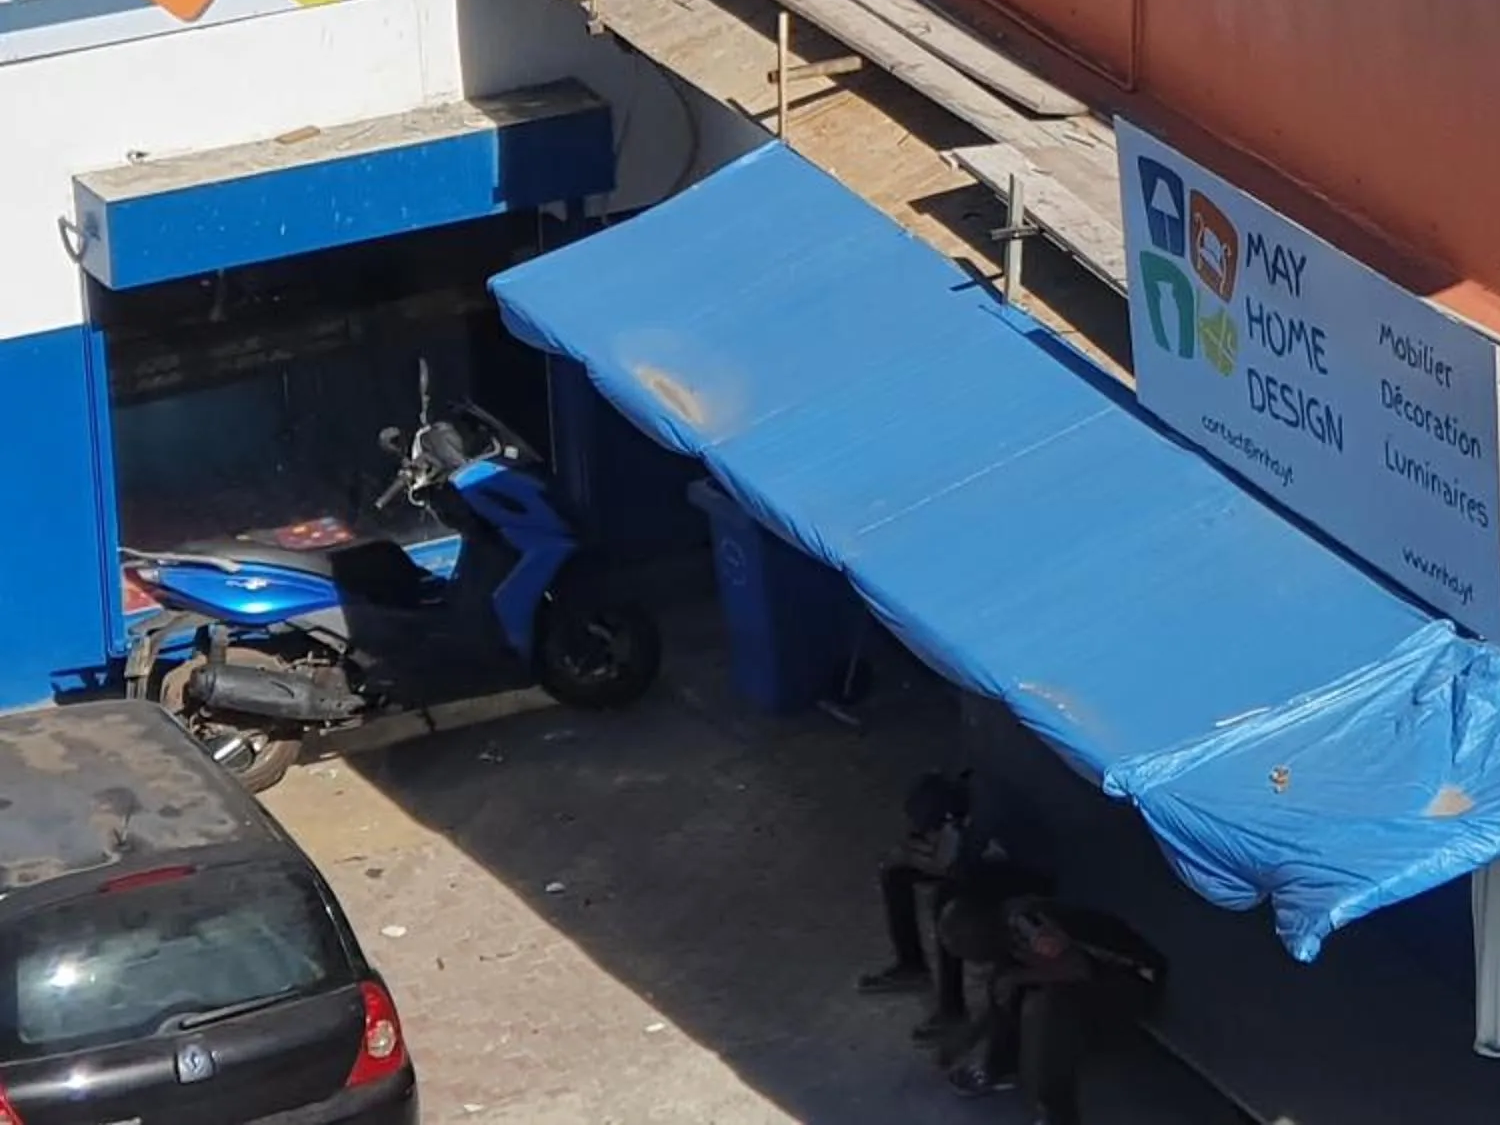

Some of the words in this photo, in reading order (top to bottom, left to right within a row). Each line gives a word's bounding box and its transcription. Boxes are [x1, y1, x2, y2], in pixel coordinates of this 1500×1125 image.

[1246, 232, 1307, 297] MAY
[1245, 295, 1329, 376] HOME
[1378, 322, 1453, 389] Mobilier
[1247, 367, 1344, 453] DESIGN
[1380, 378, 1481, 460] Décoration
[1384, 440, 1489, 529] Luminaires
